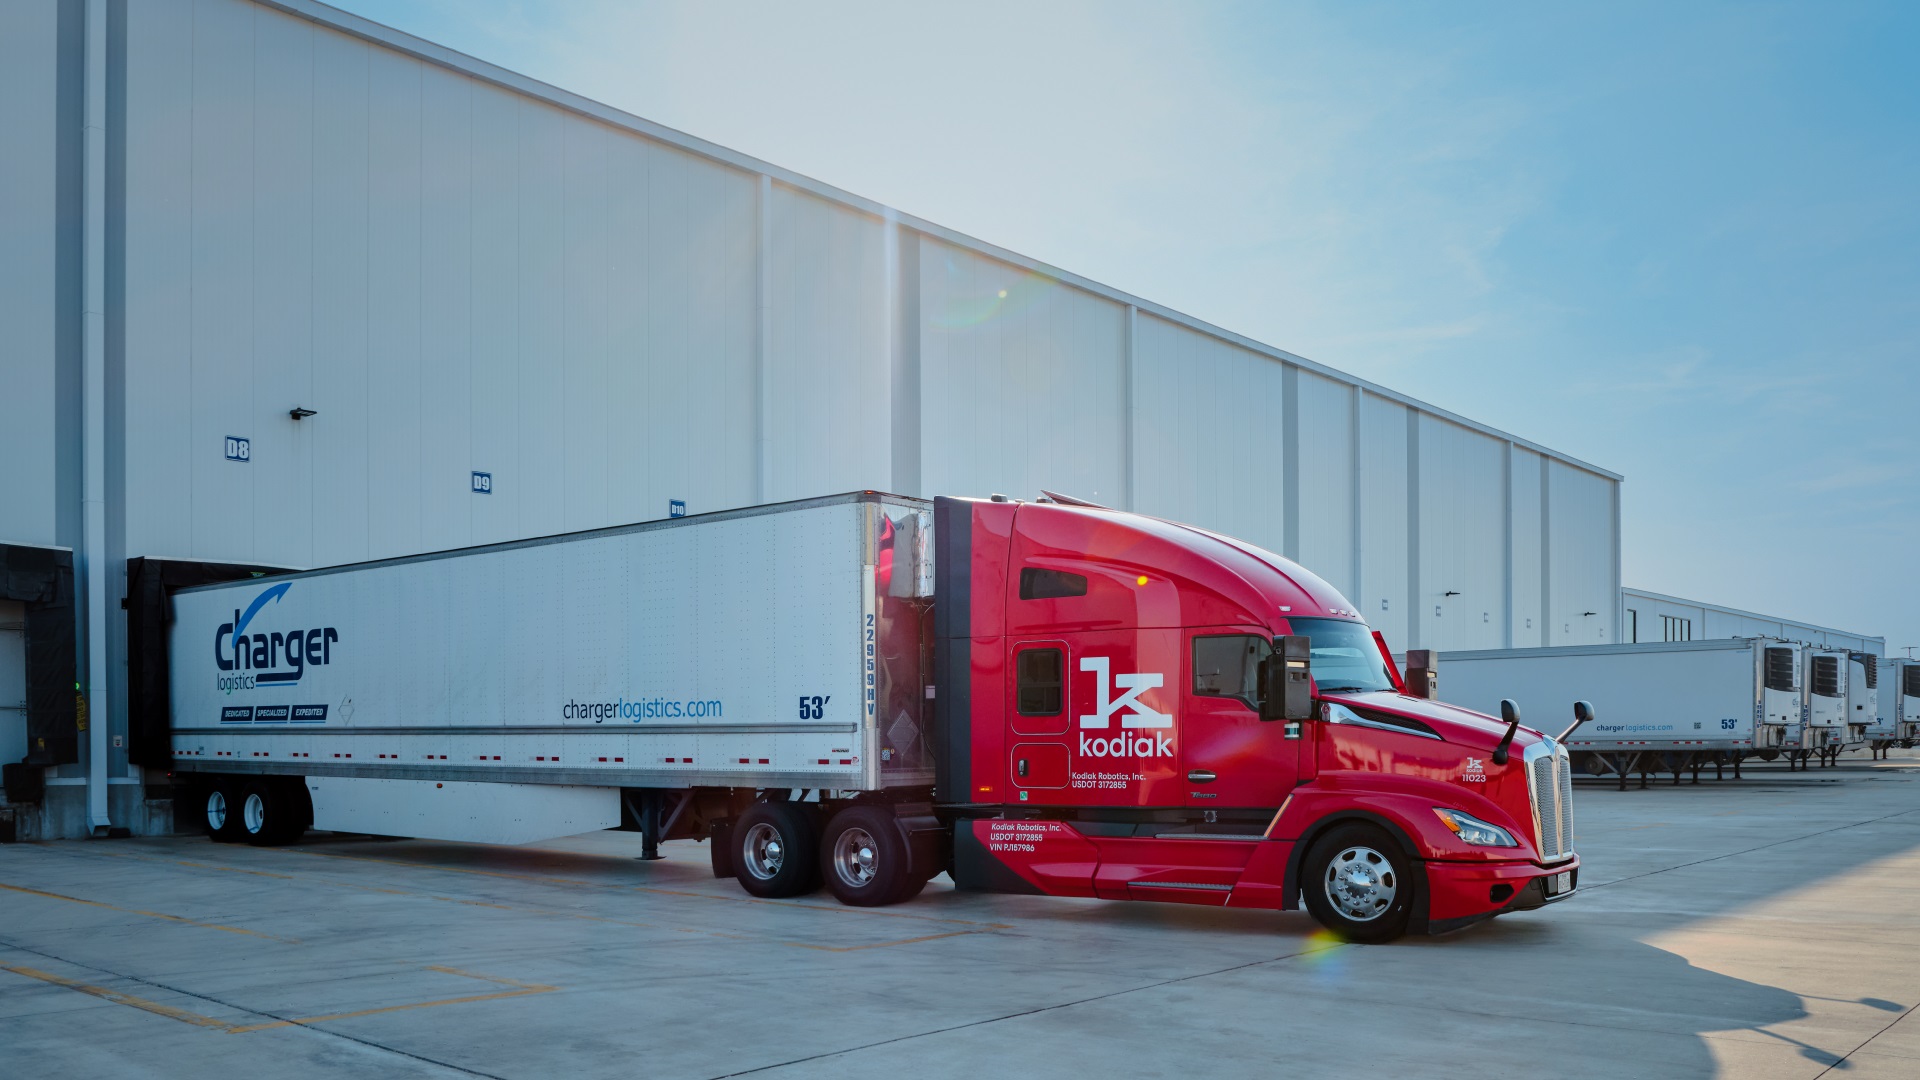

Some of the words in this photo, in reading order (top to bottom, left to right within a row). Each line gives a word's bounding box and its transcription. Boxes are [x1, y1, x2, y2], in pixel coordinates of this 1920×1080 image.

[227, 438, 249, 459] D8
[473, 475, 490, 490] D9
[671, 504, 684, 515] D10
[215, 608, 339, 683] Charger
[217, 672, 255, 696] logistics
[295, 708, 324, 716] EXPEDITED
[563, 697, 722, 724] chargerlogistics.com
[799, 695, 831, 720] 53'
[224, 709, 250, 718] DEDICATED
[257, 709, 288, 717] SPECIALIZED
[1721, 719, 1738, 730] 53'
[1079, 731, 1174, 758] kodiak
[1071, 772, 1097, 780] Kodiak
[1098, 772, 1131, 781] Robotics,
[1462, 774, 1487, 783] 11023
[1071, 780, 1097, 789] USDOT
[1098, 780, 1127, 789] 3172855
[991, 823, 1015, 831] Kodiak
[1016, 823, 1048, 832] Robotics,
[1048, 824, 1062, 832] Inc.
[990, 832, 1014, 841] USDOT
[1015, 833, 1043, 842] 3172855
[989, 843, 1002, 851] VIN
